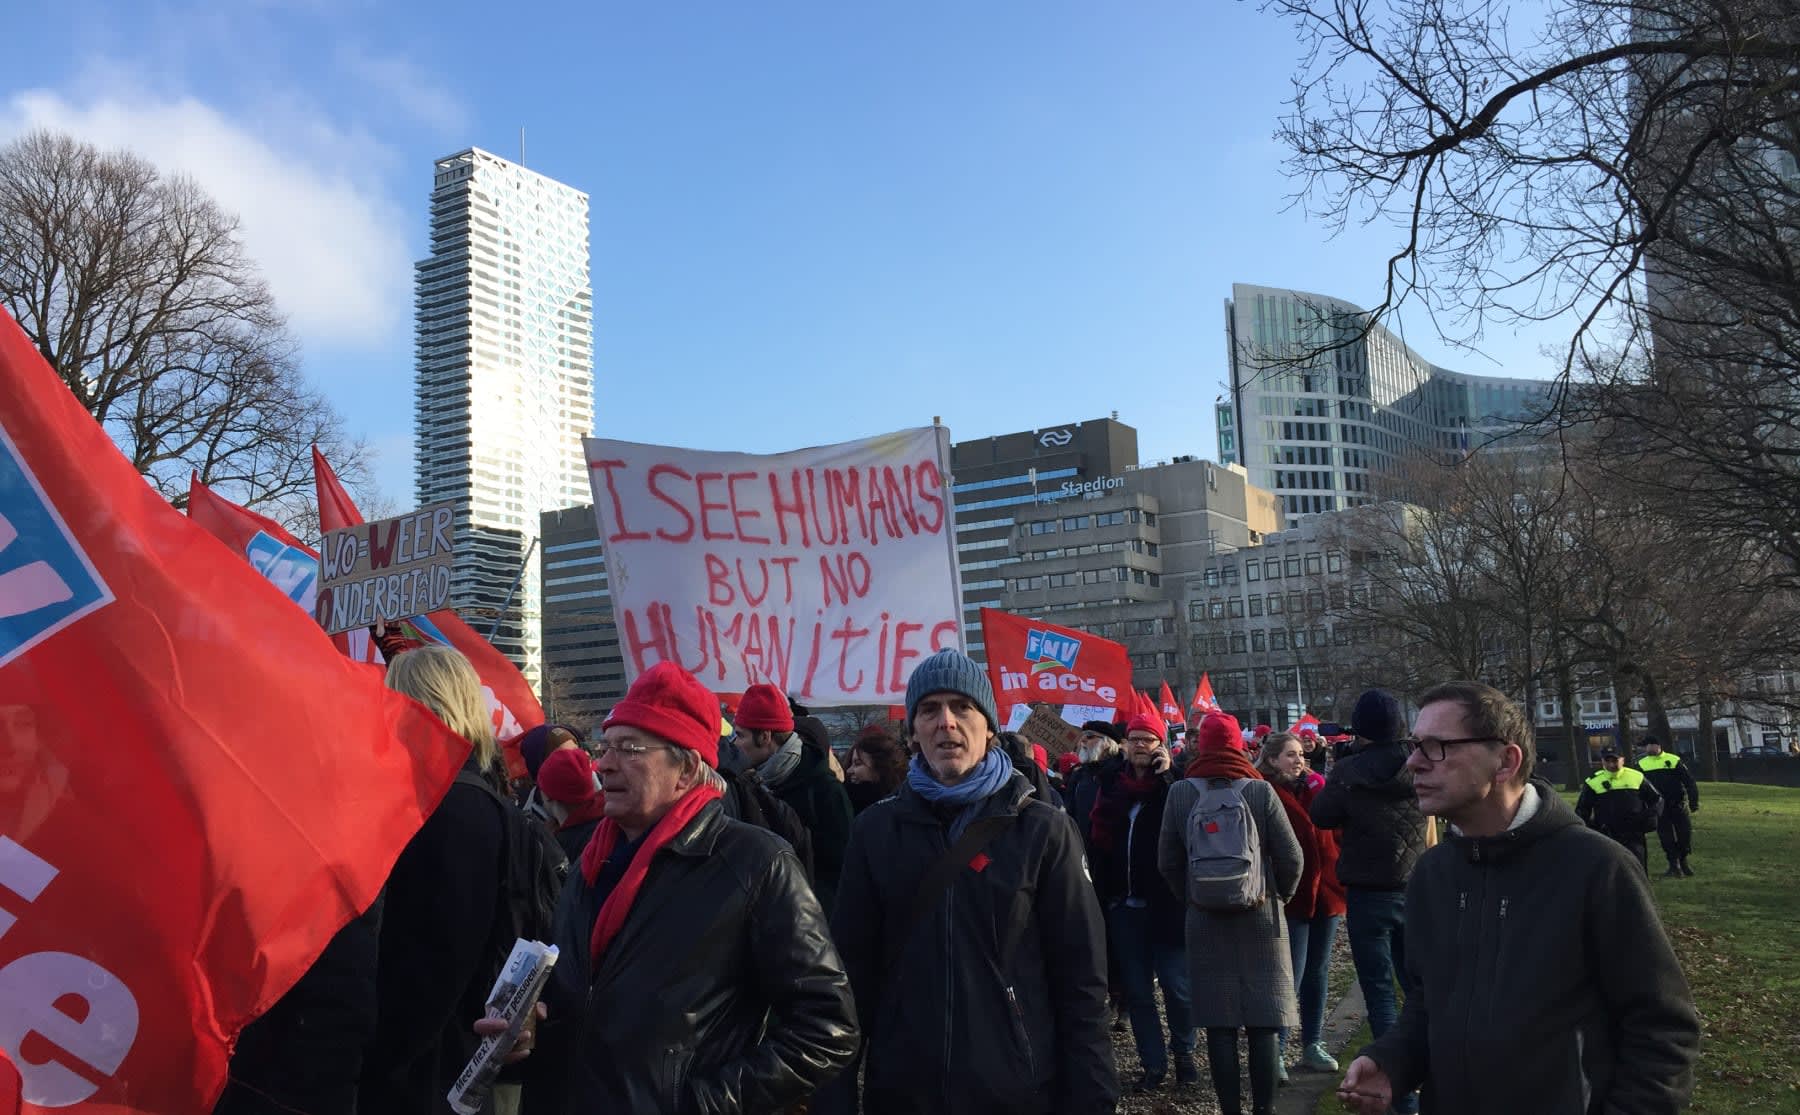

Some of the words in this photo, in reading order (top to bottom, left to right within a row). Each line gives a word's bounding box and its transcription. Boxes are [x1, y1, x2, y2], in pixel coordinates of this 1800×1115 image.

[1060, 476, 1125, 495] Staedion
[589, 459, 651, 543] I
[647, 463, 771, 545] SEE
[768, 459, 946, 549] HUMANS
[705, 552, 800, 607] BUT
[820, 551, 872, 607] NO
[1029, 635, 1079, 662] FNV
[1000, 665, 1029, 691] in
